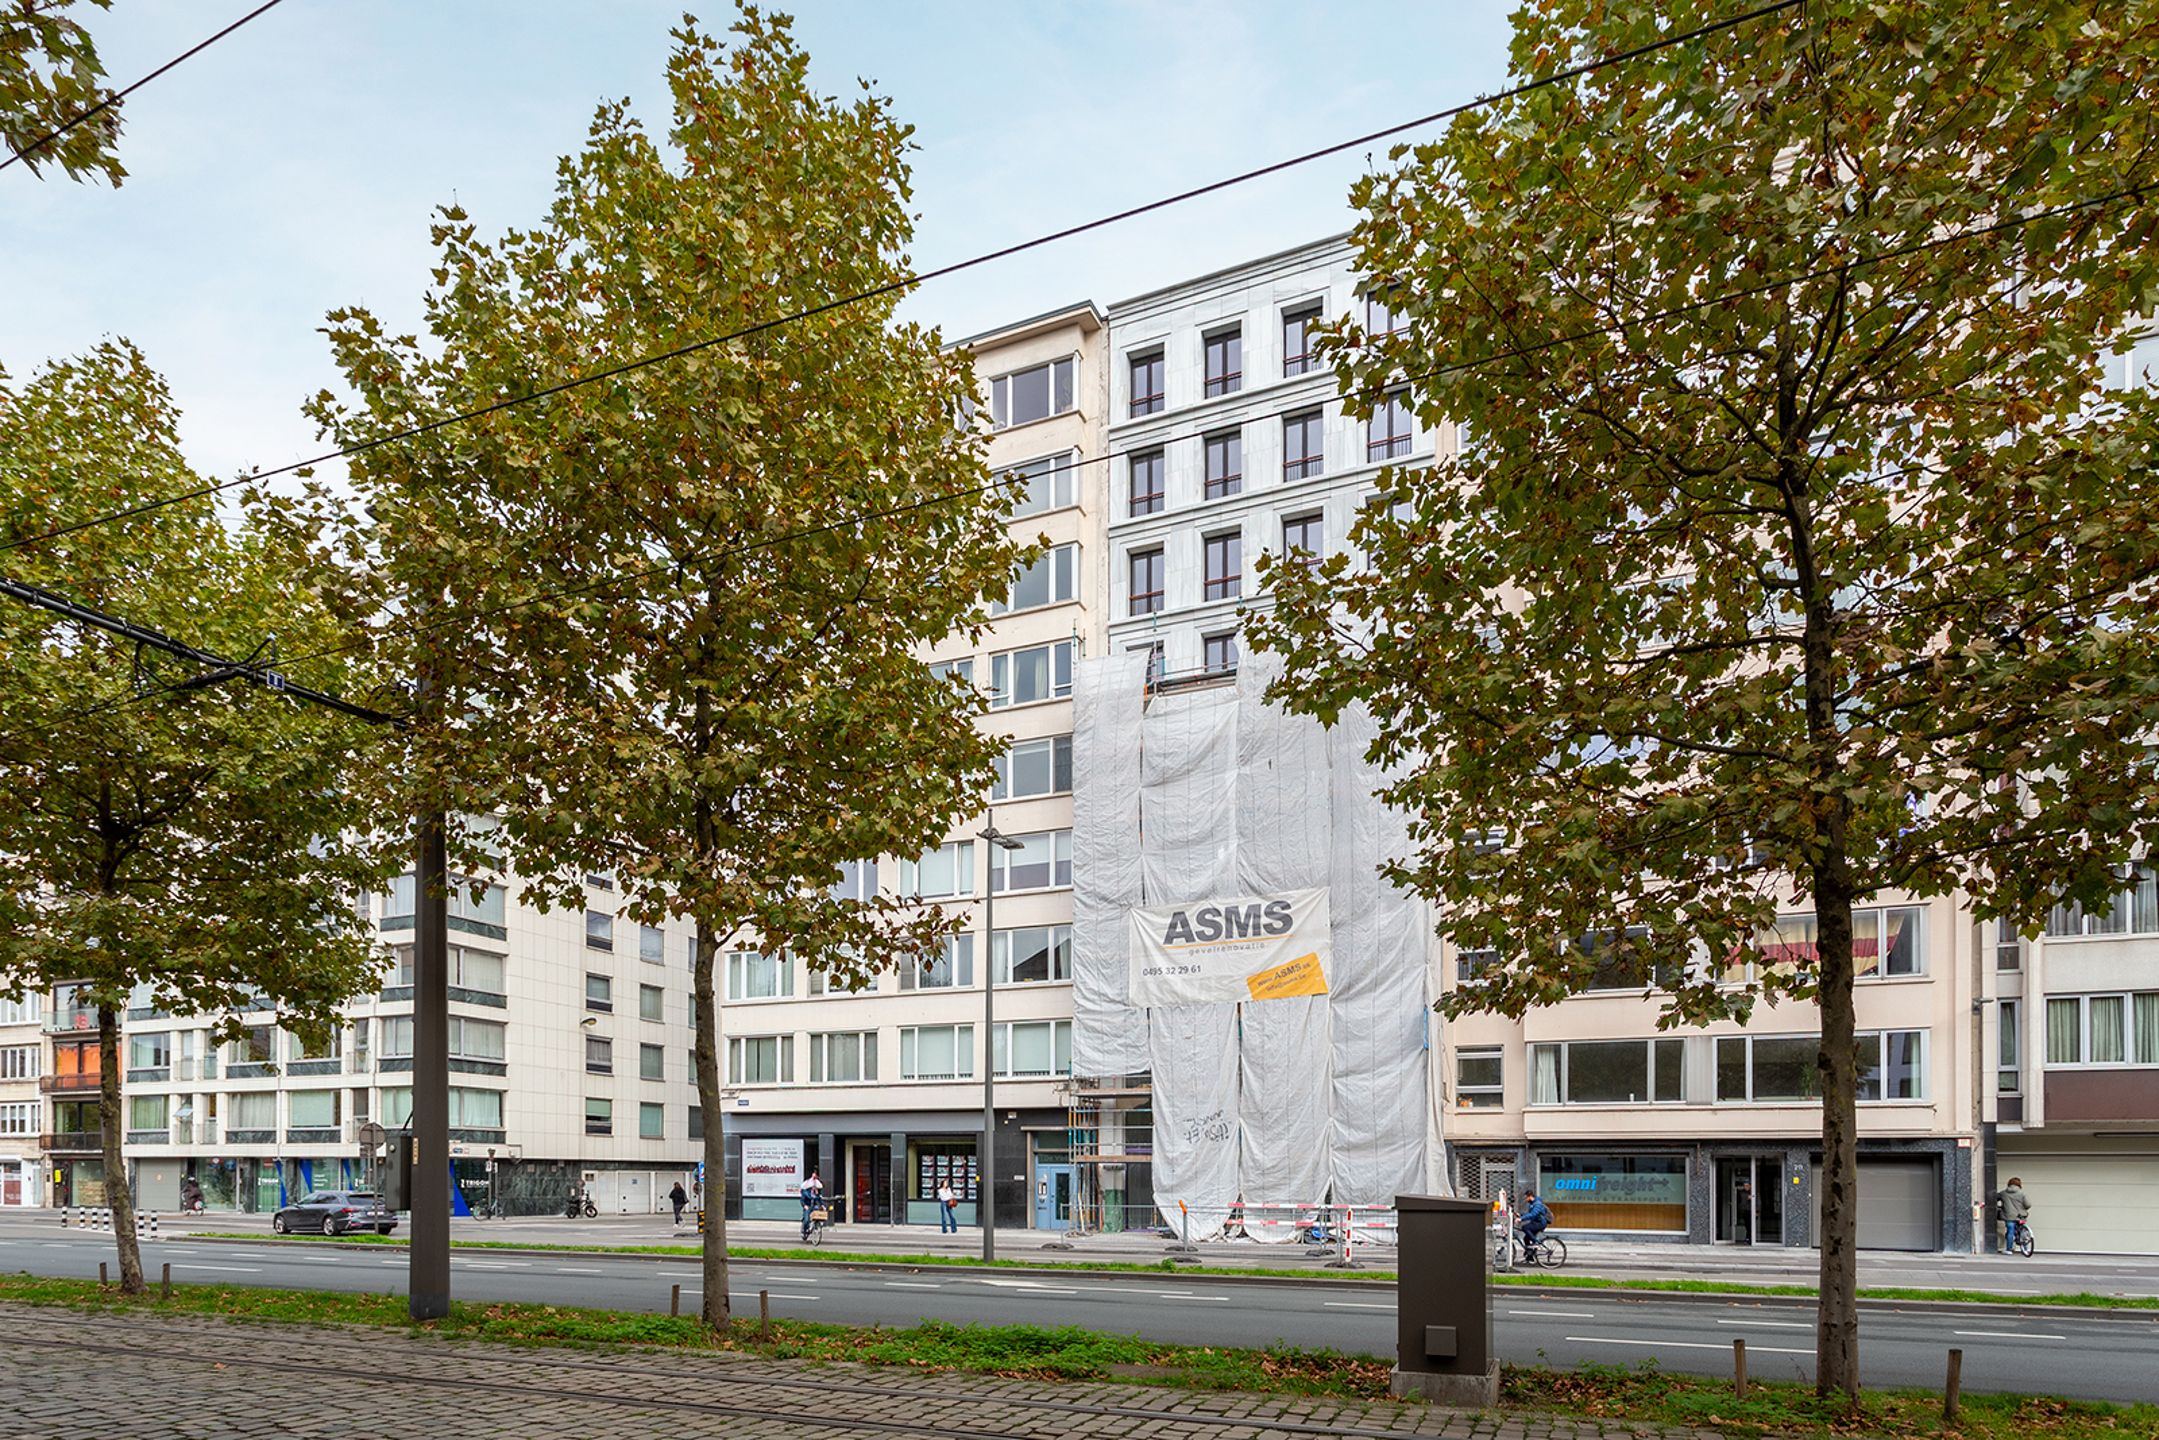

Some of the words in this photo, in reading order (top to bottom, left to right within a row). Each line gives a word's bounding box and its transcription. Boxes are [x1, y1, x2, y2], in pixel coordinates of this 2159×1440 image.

[1163, 900, 1294, 945] ASMS
[1142, 967, 1163, 976] 0495
[1165, 966, 1176, 975] 32
[1178, 965, 1189, 974] 29
[1191, 964, 1201, 973] 61
